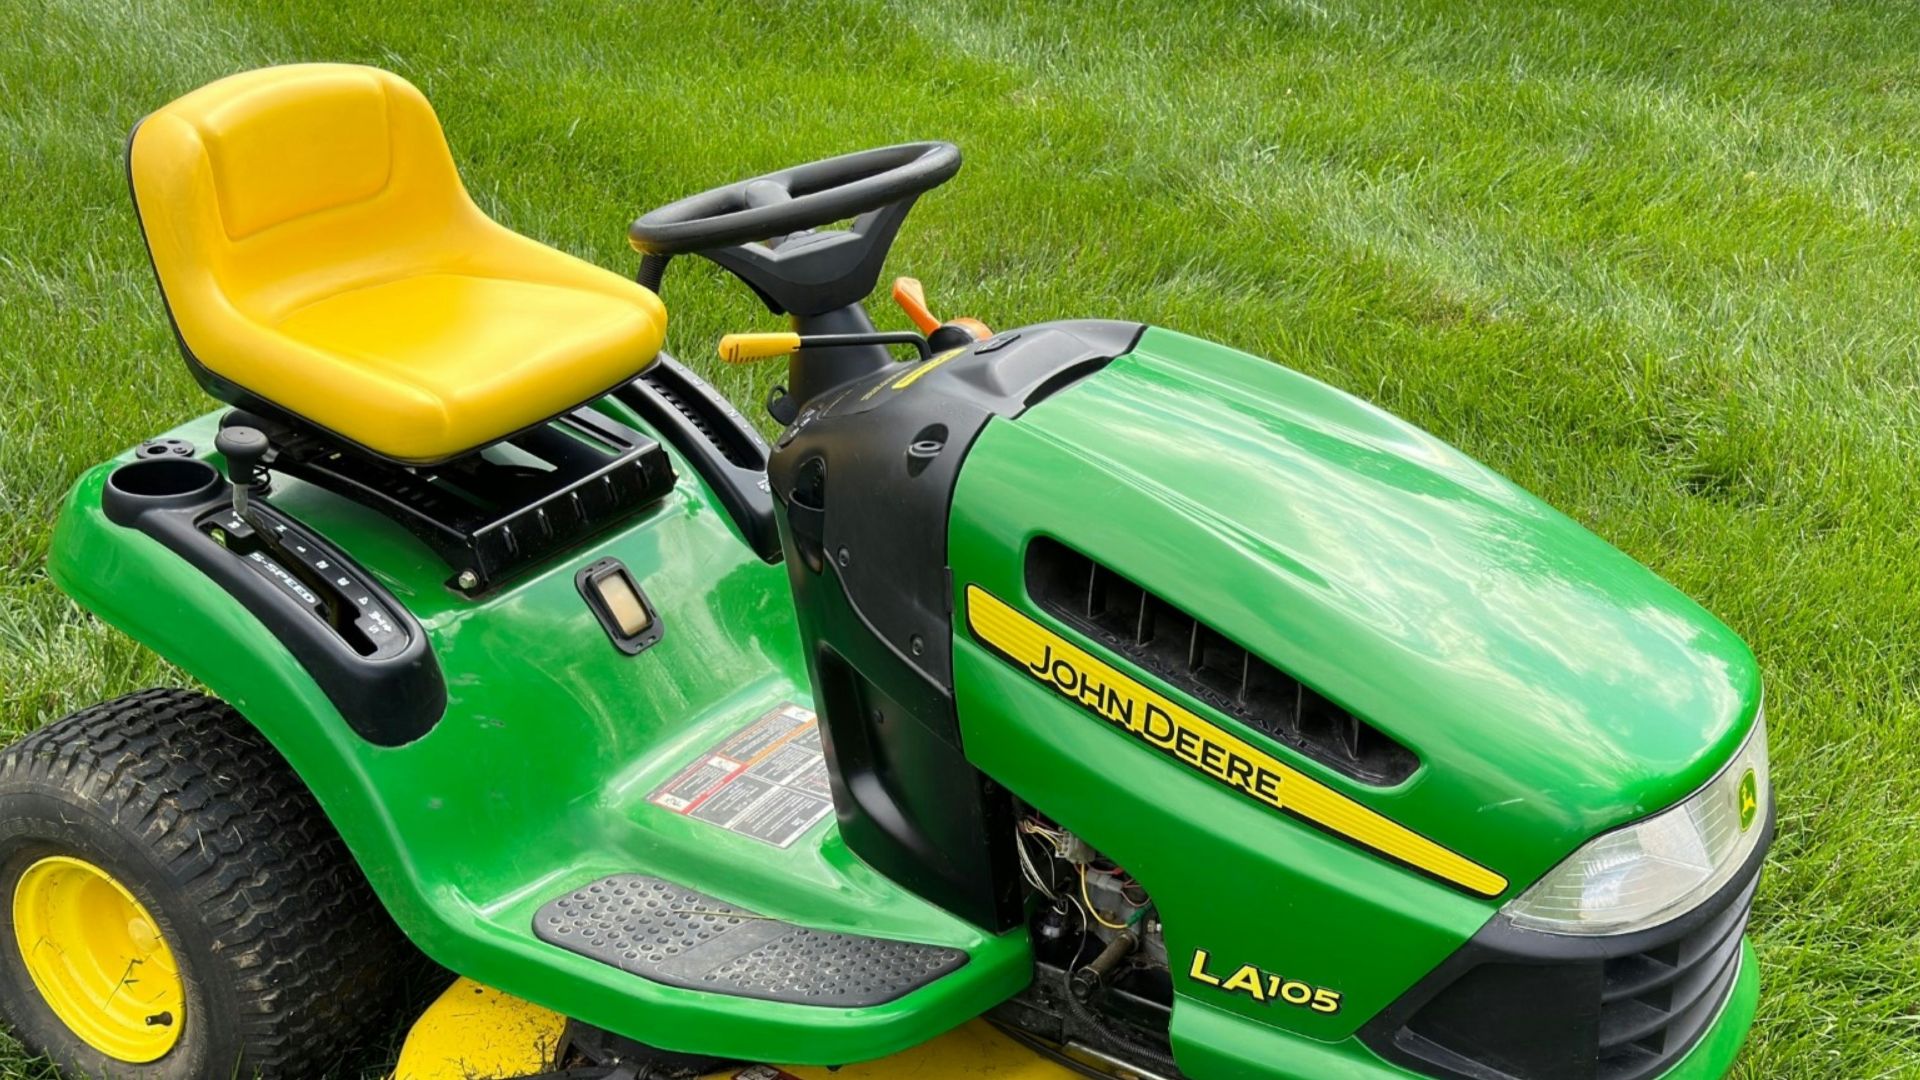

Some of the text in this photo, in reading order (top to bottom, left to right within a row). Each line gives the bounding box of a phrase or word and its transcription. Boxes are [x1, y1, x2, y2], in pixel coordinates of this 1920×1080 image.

[249, 552, 316, 603] 5-SPEED
[1029, 645, 1282, 802] JOHN DEERE
[1189, 948, 1341, 1014] LA105
